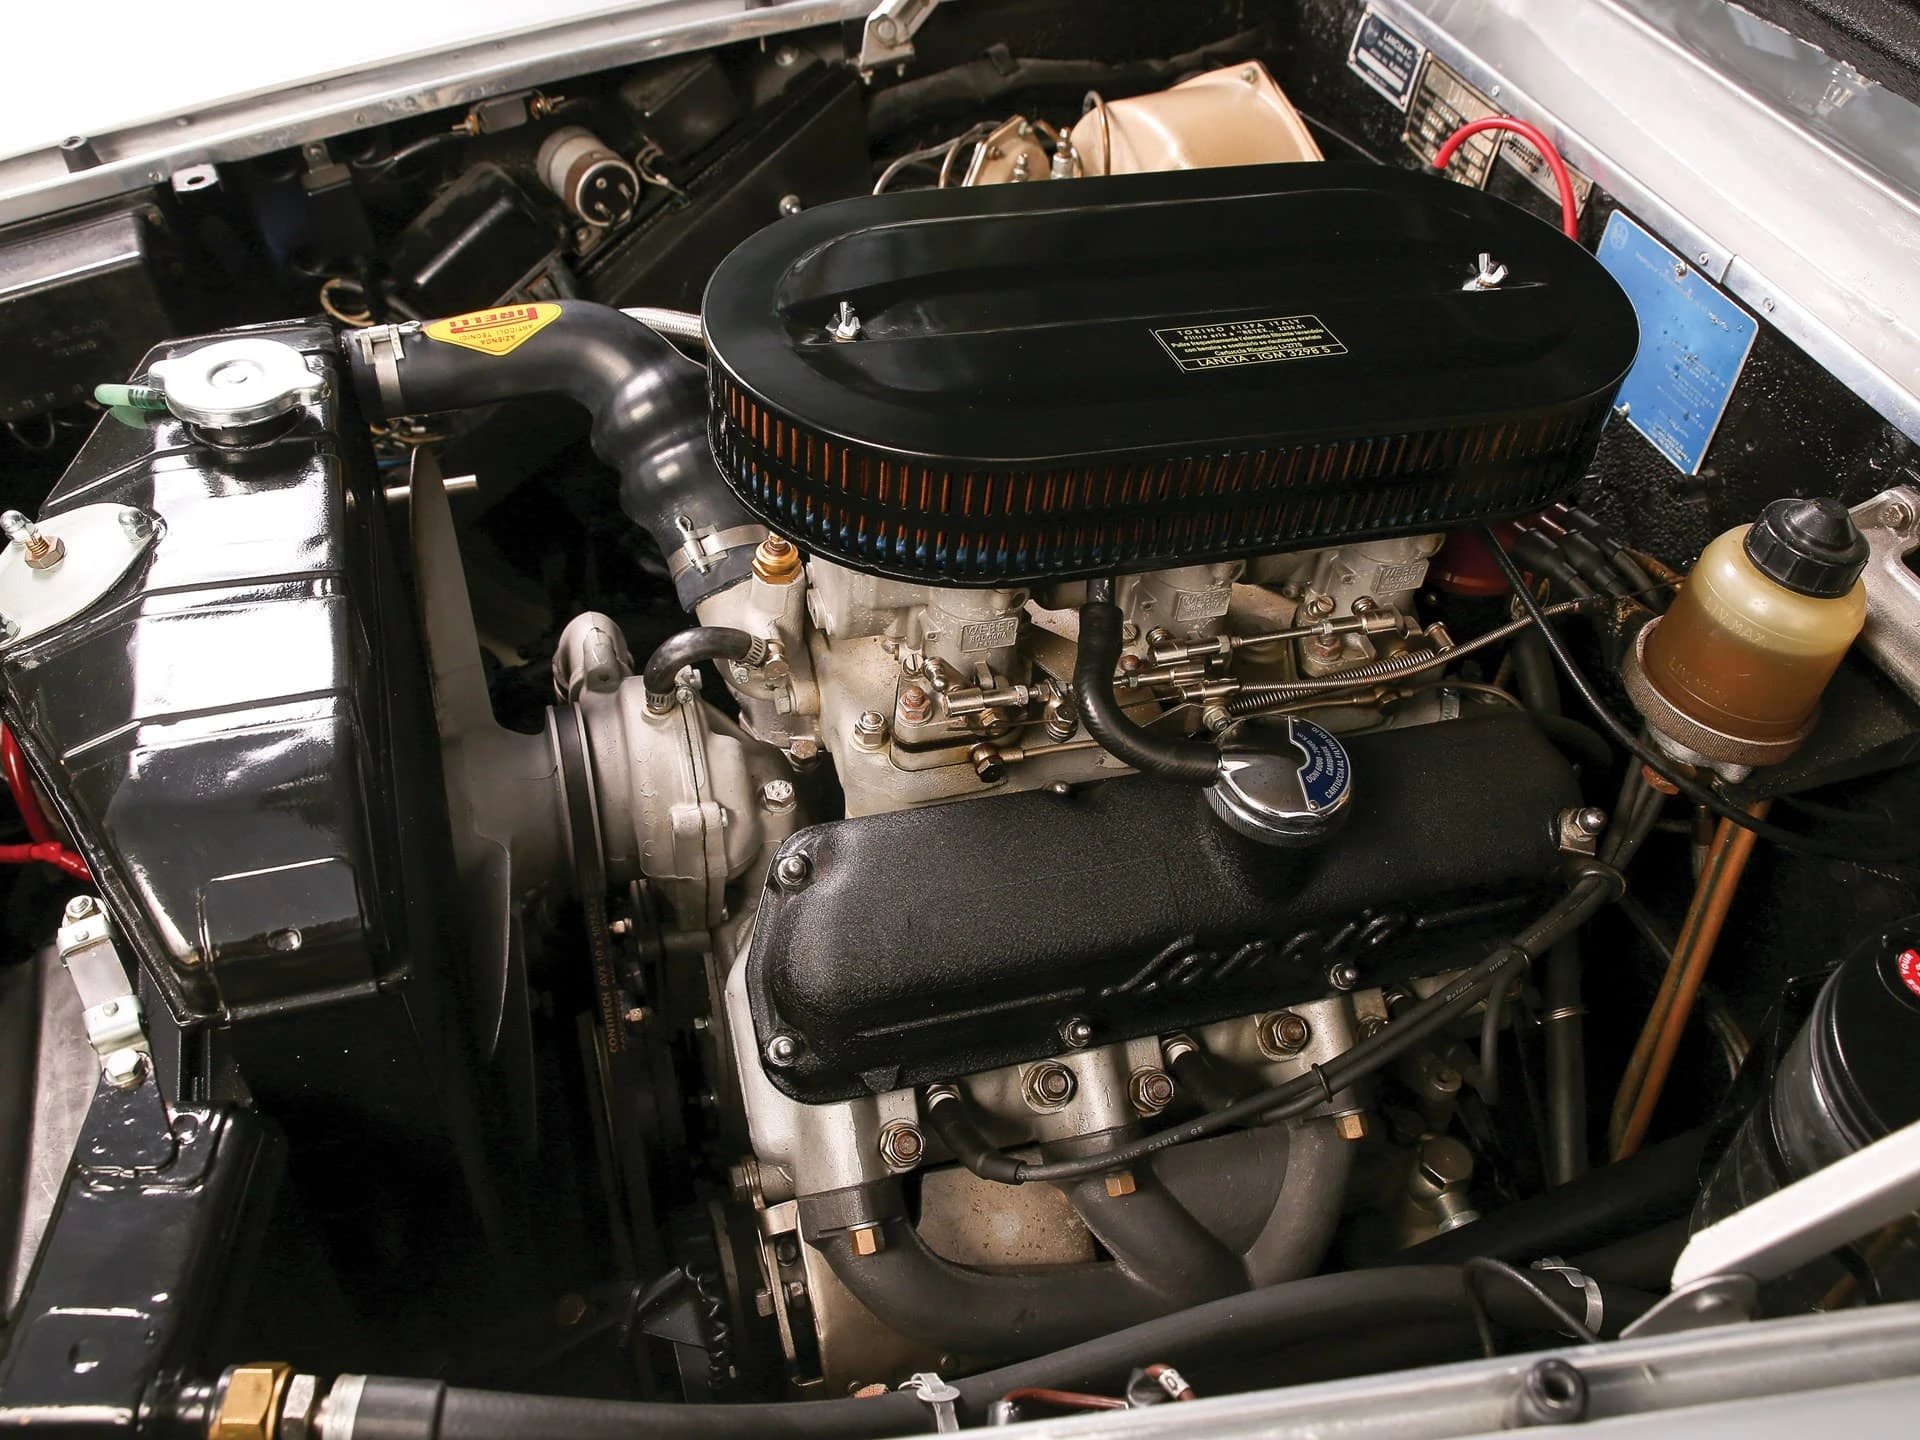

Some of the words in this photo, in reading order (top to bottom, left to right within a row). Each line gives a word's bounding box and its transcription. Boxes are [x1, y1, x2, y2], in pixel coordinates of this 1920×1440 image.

[459, 331, 492, 341] TECNICI
[496, 323, 534, 337] ARTICOLI
[1177, 327, 1225, 335] TORINO
[1231, 322, 1265, 331] FISPA
[1269, 319, 1301, 327] ITALY
[480, 334, 516, 345] AZIENDA
[1196, 355, 1250, 367] LANCIA
[1256, 351, 1287, 361] IGM
[1287, 346, 1320, 357] 3298
[967, 620, 1015, 635] WEBER
[970, 631, 1008, 642] BOLOGNA
[1320, 745, 1335, 776] CAMBIARE
[1305, 769, 1321, 784] OGNI
[1324, 767, 1345, 799] CARTUCCIA
[1901, 952, 1914, 975] YOUR
[598, 965, 609, 986] AVX
[1445, 981, 1473, 1002] Belden
[602, 991, 617, 1053] CONTITECH
[1147, 1133, 1180, 1151] CABLE
